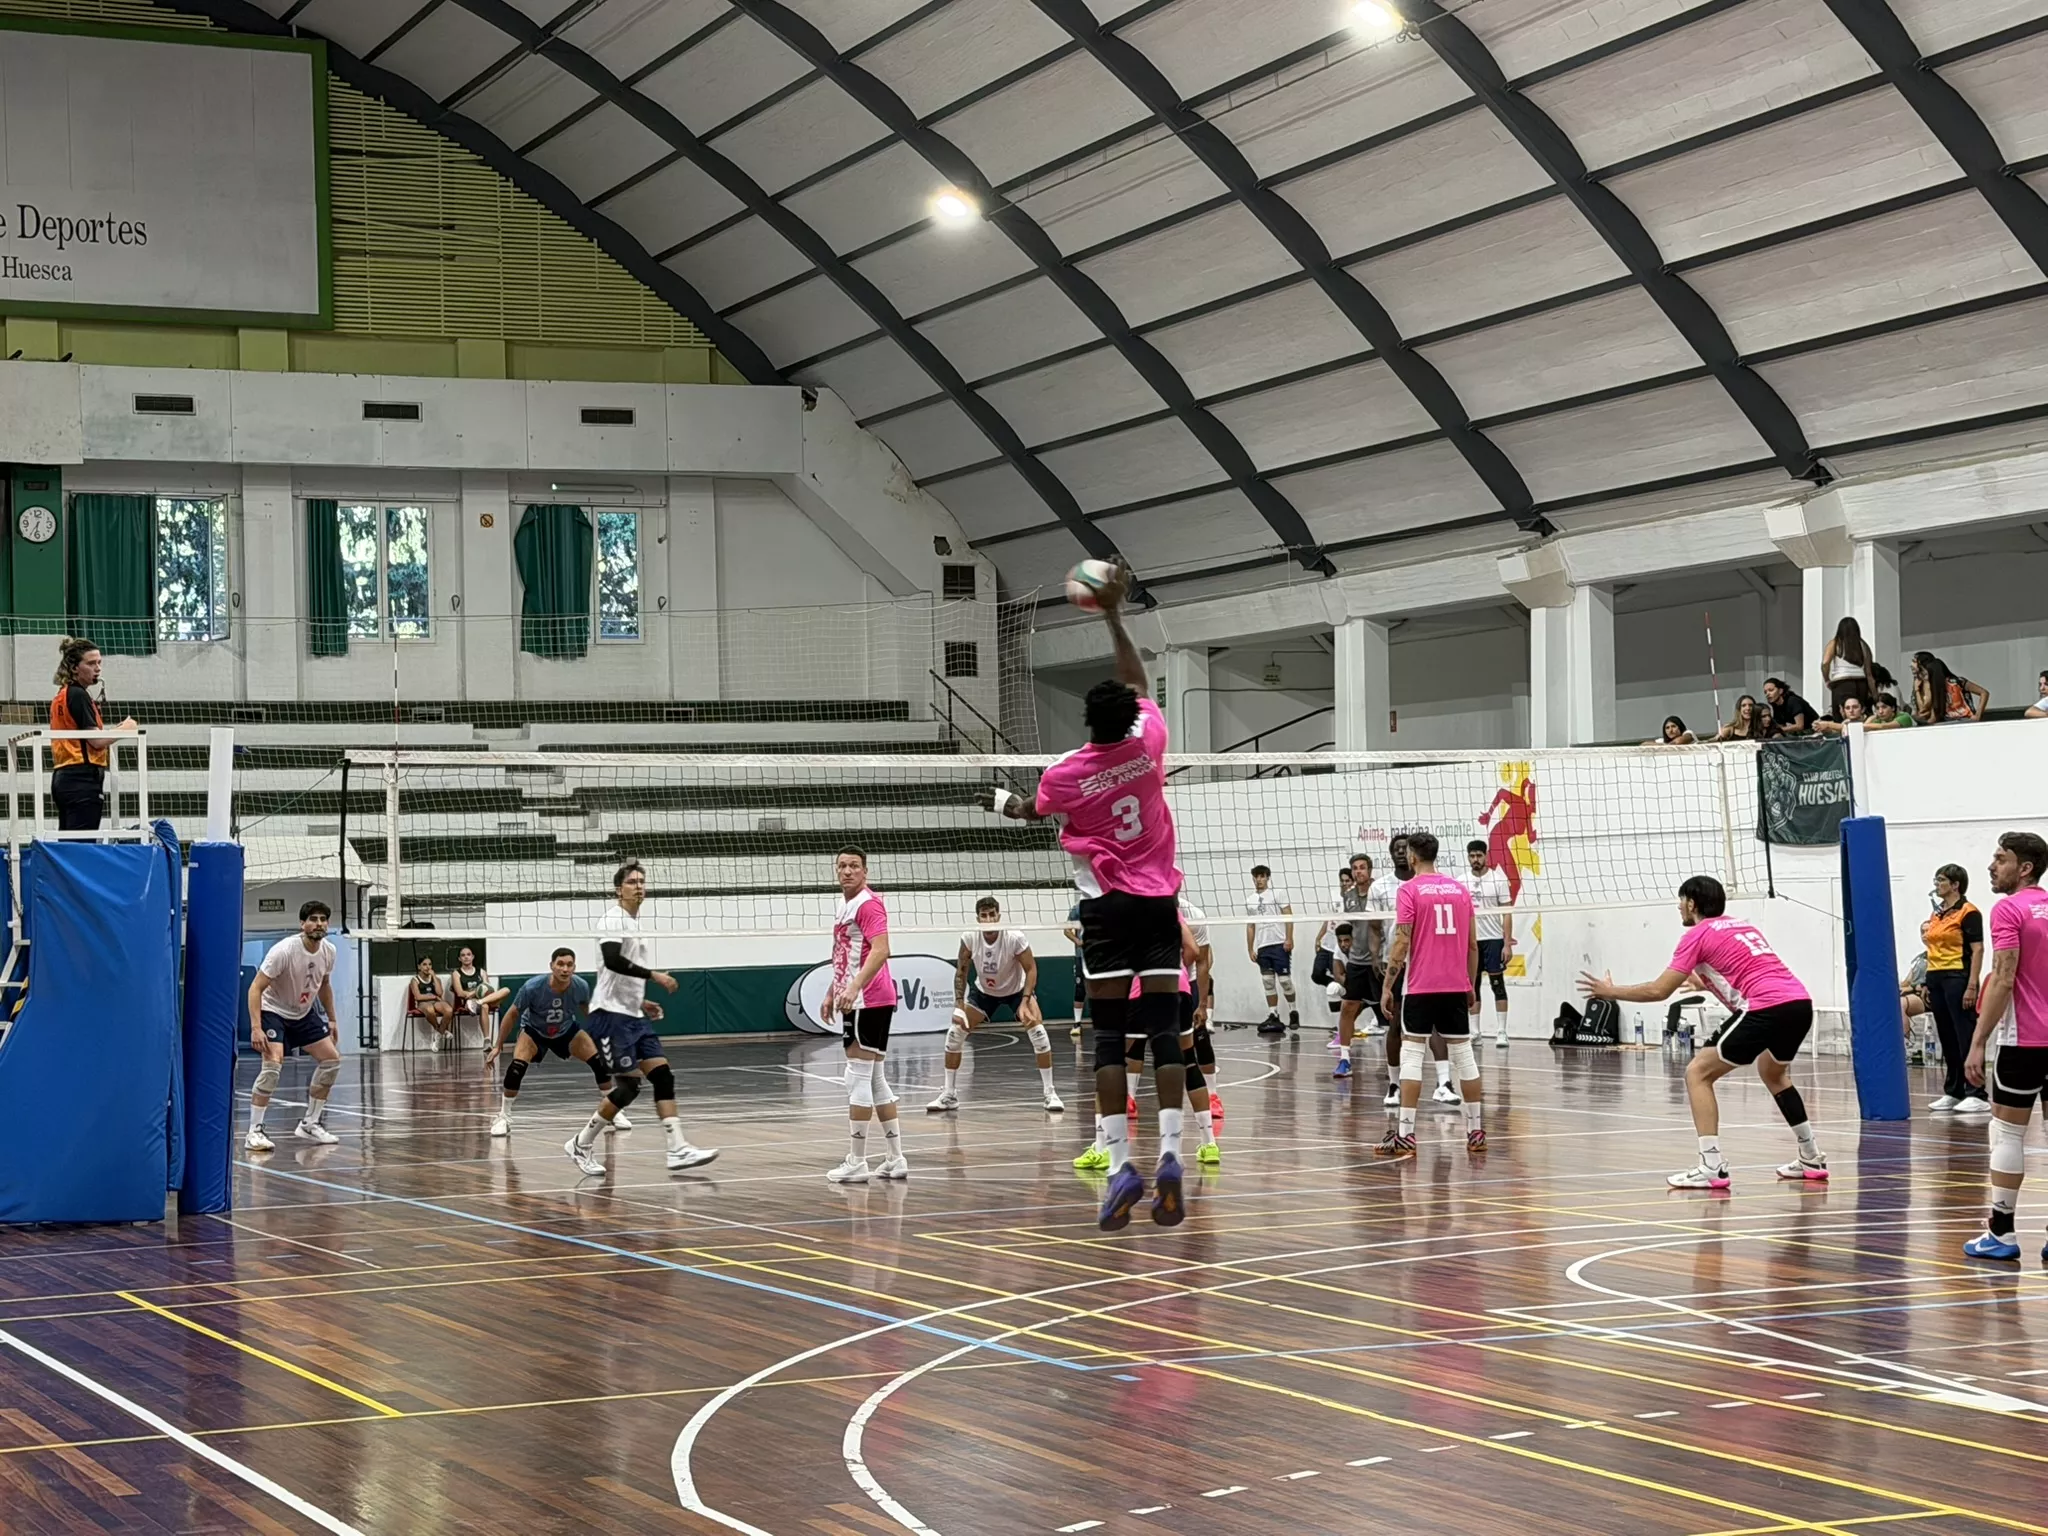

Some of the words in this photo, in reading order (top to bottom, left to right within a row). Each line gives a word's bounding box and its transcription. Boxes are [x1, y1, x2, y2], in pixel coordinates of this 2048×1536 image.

[16, 203, 148, 250] Deportes
[1, 255, 73, 281] Huesca
[1097, 753, 1150, 780] GOBIERNO
[1100, 777, 1116, 791] DE
[1111, 794, 1143, 842] 3
[1357, 823, 1388, 843] Anima,
[1433, 903, 1457, 935] 11
[546, 1009, 564, 1023] 23
